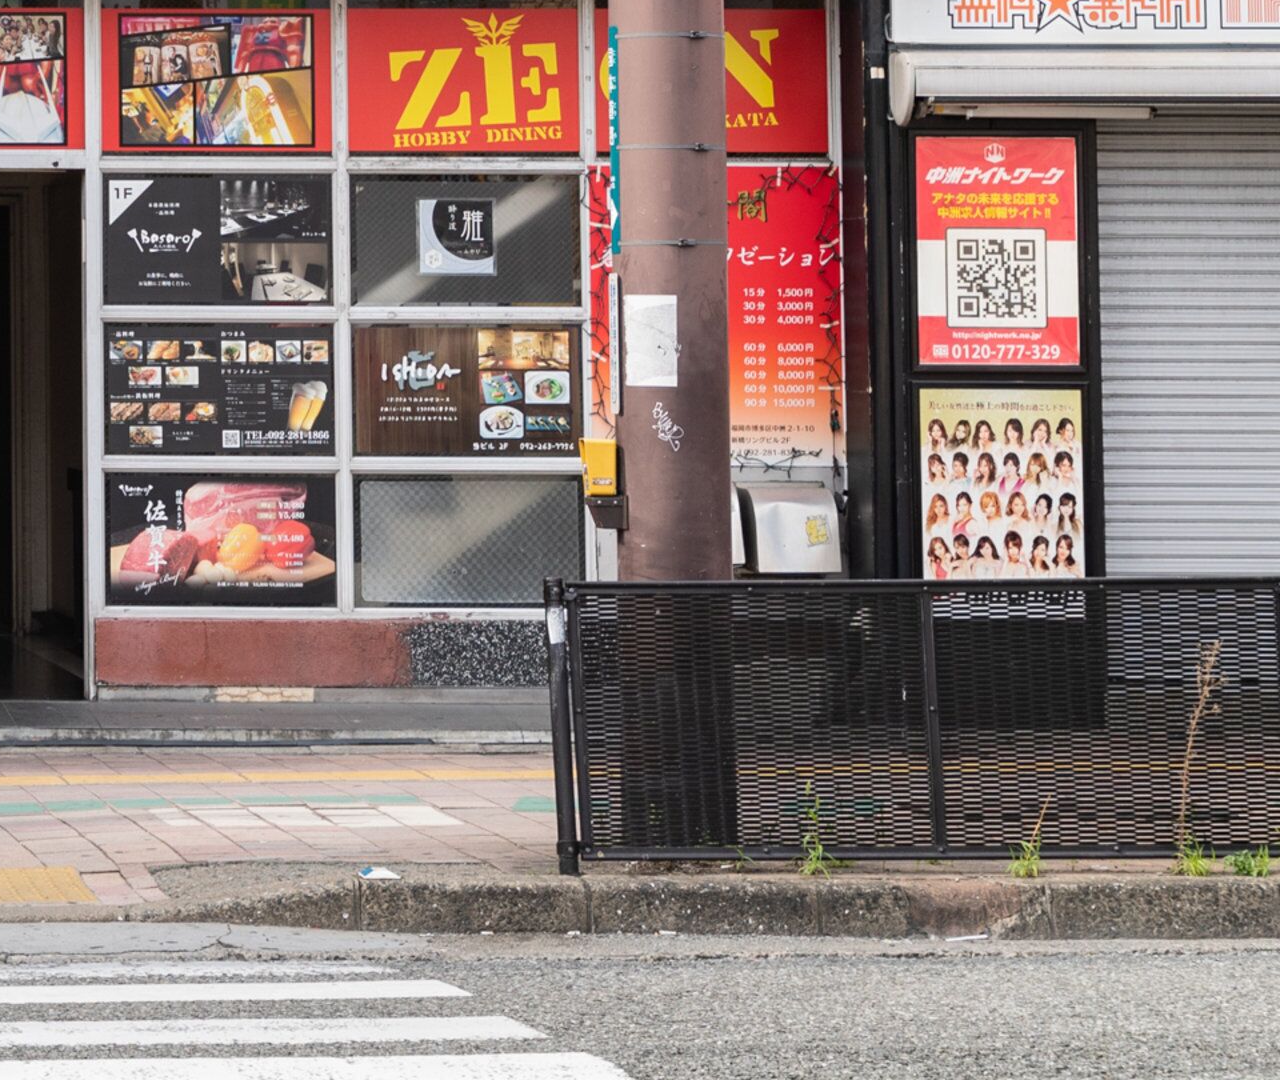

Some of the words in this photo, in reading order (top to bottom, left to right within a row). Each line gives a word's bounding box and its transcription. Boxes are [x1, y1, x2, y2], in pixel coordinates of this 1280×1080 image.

[393, 130, 472, 148] HOBBY
[486, 125, 563, 144] DINING
[925, 166, 1065, 185] 中洲ナイトワーク
[114, 187, 133, 199] 1F
[931, 192, 1060, 205] アナタの未来を応援する
[460, 209, 484, 241] 雅
[743, 287, 765, 297] 15分
[743, 301, 765, 311] 30分
[743, 315, 765, 325] 30分
[952, 344, 1061, 360] 0120-777-329
[143, 500, 169, 573] 佐賀牛
